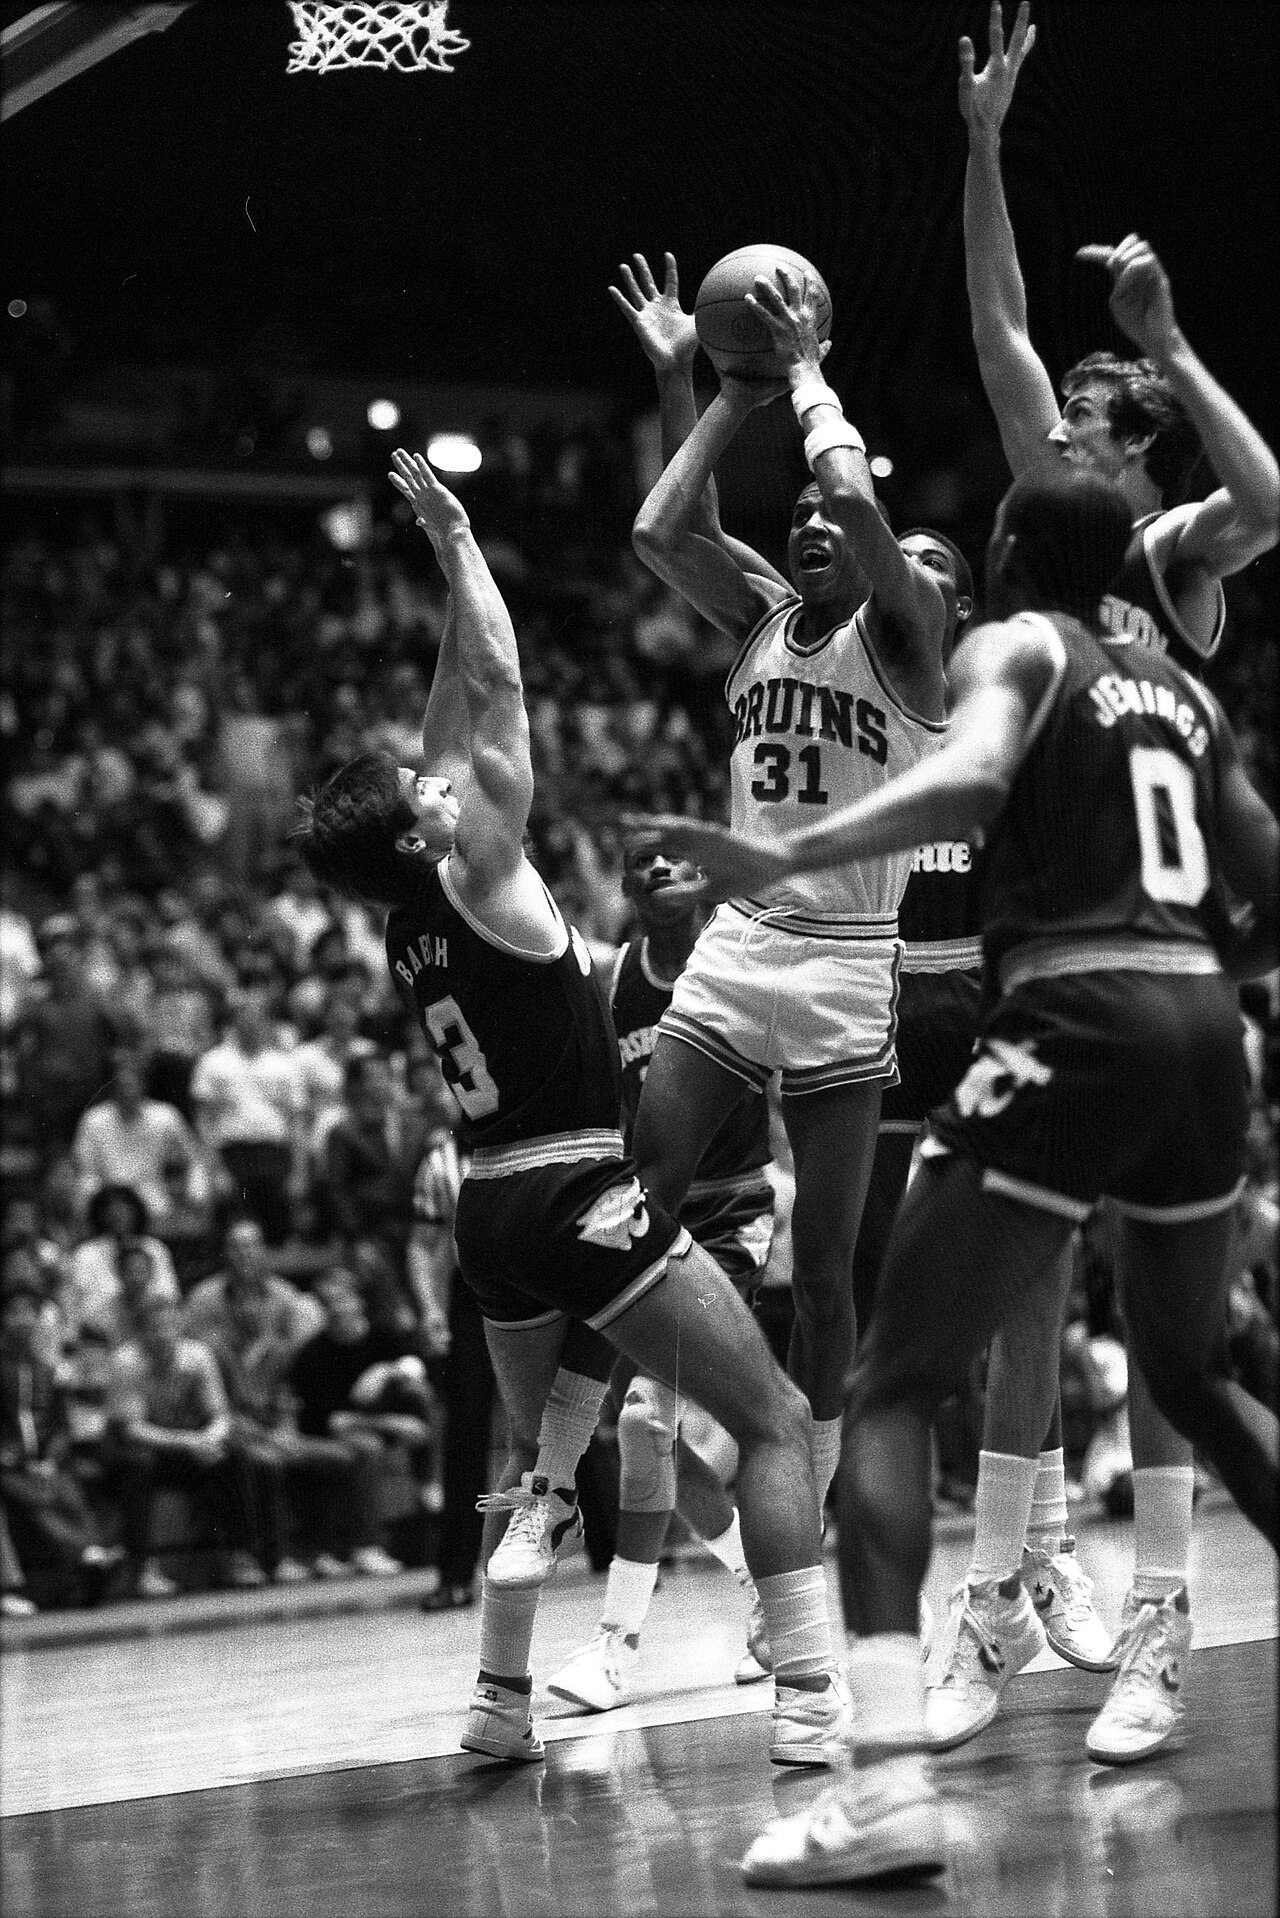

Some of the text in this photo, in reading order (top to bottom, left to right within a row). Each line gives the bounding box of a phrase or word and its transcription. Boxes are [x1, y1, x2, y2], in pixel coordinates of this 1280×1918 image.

[735, 677, 888, 766] BRUINS
[751, 743, 828, 804] 31
[1130, 745, 1211, 908] 0
[425, 995, 499, 1121] 3
